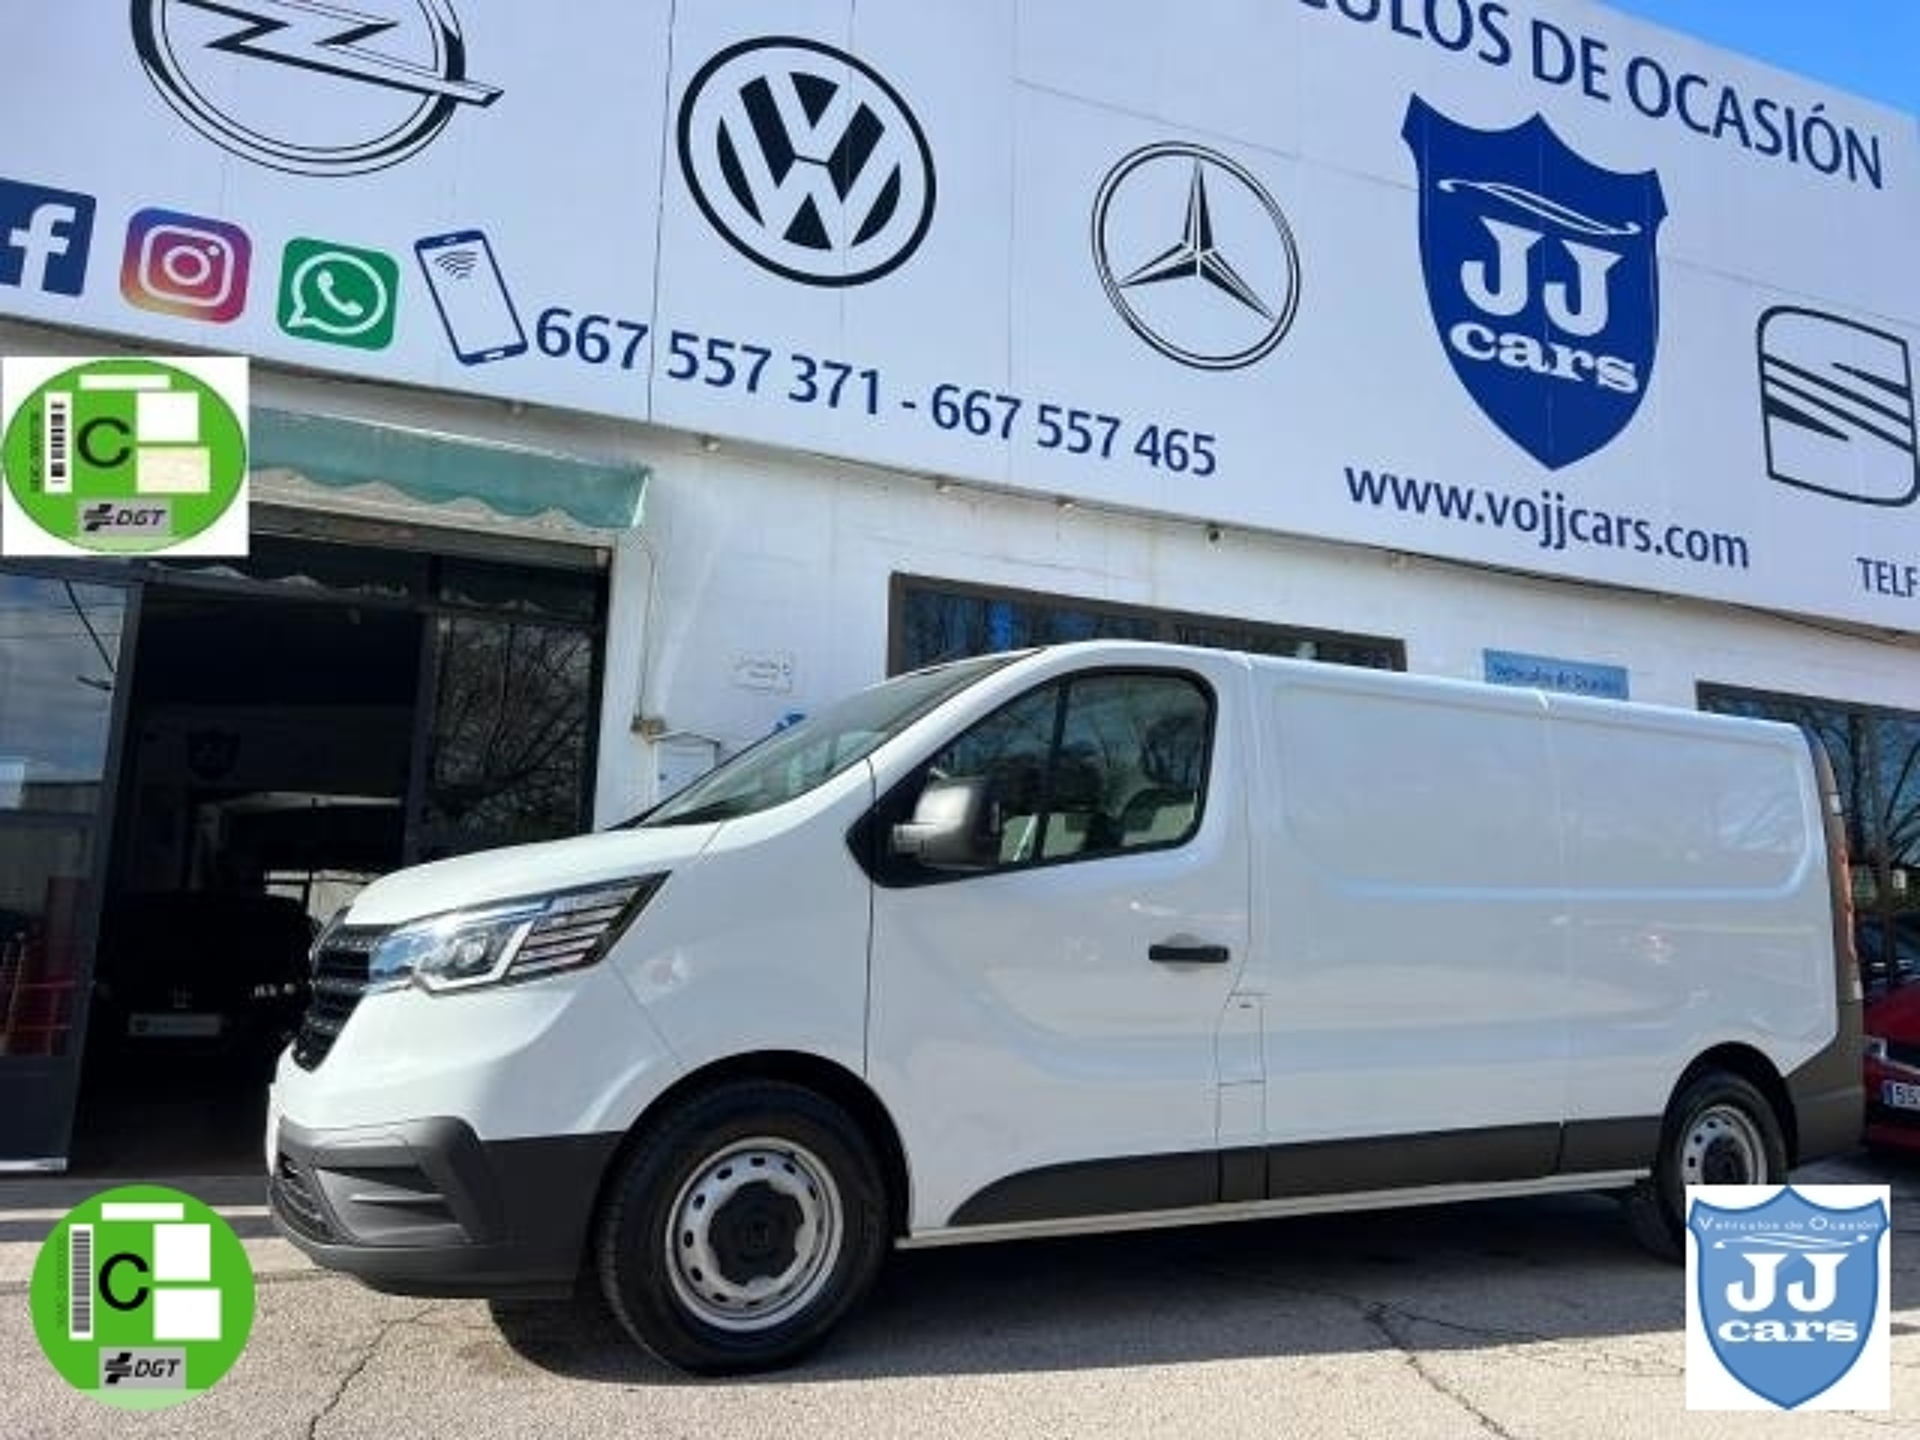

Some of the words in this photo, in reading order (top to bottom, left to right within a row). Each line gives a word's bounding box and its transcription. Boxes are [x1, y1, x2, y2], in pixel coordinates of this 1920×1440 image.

[1532, 19, 1612, 101] DE
[1627, 56, 1883, 190] OCASIÓN
[1460, 215, 1624, 336] JJ
[536, 308, 649, 370] 667
[666, 332, 773, 395] 557
[788, 355, 880, 416] 371
[932, 384, 1022, 440] 667
[1036, 404, 1121, 458] 557
[1133, 425, 1218, 477] 465
[1450, 322, 1639, 394] cars
[1344, 467, 1750, 568] www.vojjcars.com
